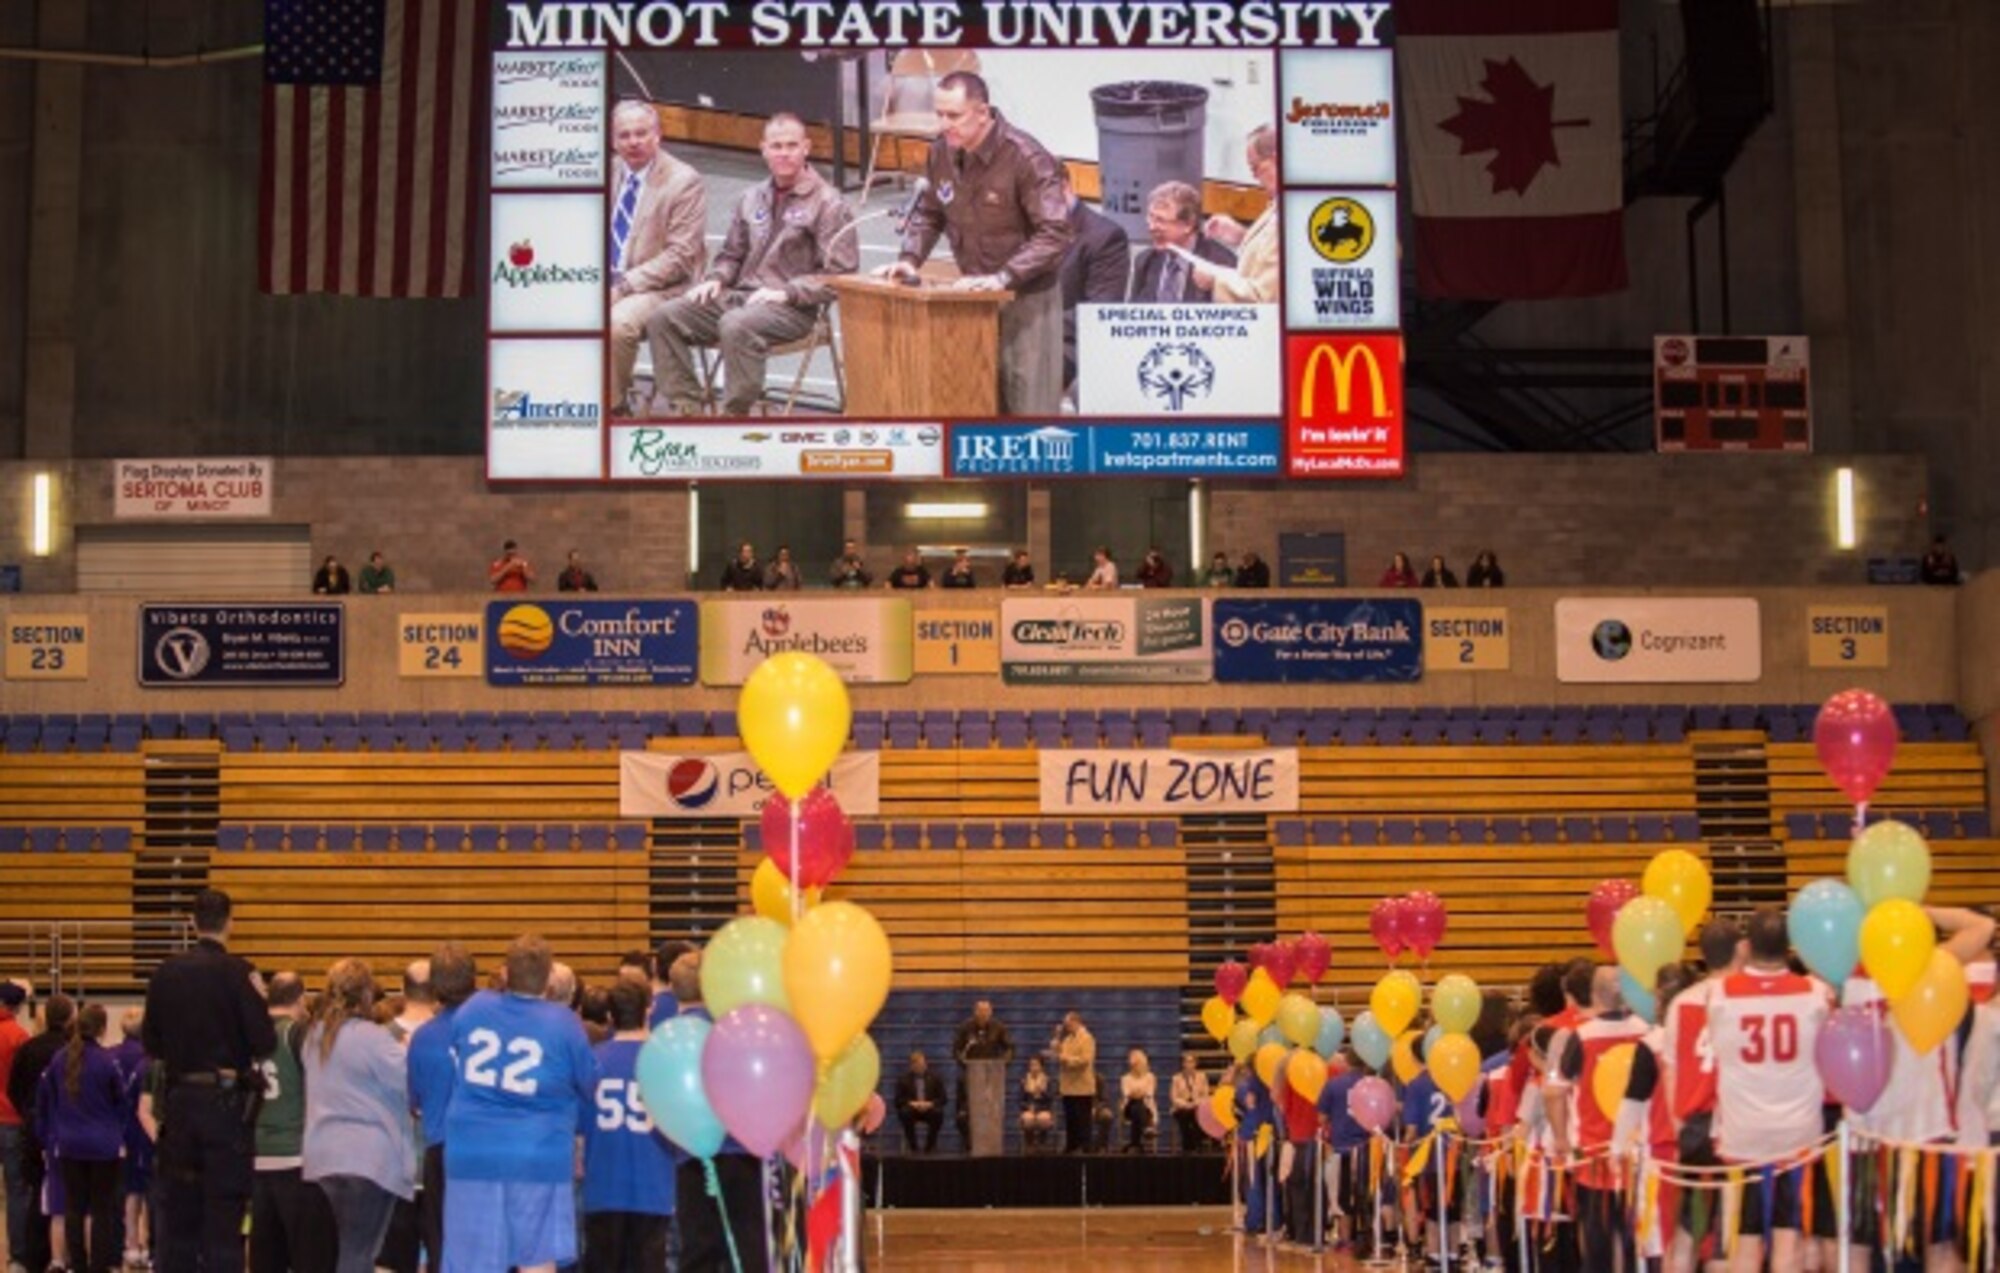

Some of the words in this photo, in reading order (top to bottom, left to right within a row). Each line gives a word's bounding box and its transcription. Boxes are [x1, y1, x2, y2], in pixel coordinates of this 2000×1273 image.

[506, 3, 728, 47] MINOT
[751, 3, 964, 46] STATE
[985, 2, 1390, 46] UNIVERSITY
[1312, 281, 1374, 298] WILD
[1098, 309, 1167, 321] SPECIAL
[1172, 309, 1258, 321] OLYMPICS
[1312, 299, 1374, 314] WINGS
[1110, 325, 1171, 337] NORTH
[1175, 325, 1249, 337] DAKOTA
[957, 435, 1048, 460] IRET
[1131, 432, 1249, 448] 701.837.RENT
[629, 428, 697, 475] Ryan
[956, 459, 1073, 472] PROPERTIES
[123, 481, 207, 498] SERTOMA
[214, 480, 263, 498] CLUB
[187, 500, 231, 512] MINOT
[216, 609, 337, 625] Orthodontics
[559, 609, 676, 636] Comfort
[1812, 617, 1884, 634] SECTION
[12, 626, 84, 644] SECTION
[403, 625, 478, 643] SECTION
[918, 620, 993, 639] SECTION
[1252, 622, 1301, 644] Gate
[1305, 620, 1347, 647] City
[1353, 619, 1410, 642] Bank
[1430, 620, 1504, 637] SECTION
[594, 639, 641, 657] INN
[1640, 630, 1727, 653] Cognizant
[1840, 639, 1856, 660] 3
[31, 648, 65, 669] 23
[425, 647, 461, 669] 24
[949, 644, 958, 665] 1
[1459, 640, 1475, 663] 2
[1066, 759, 1149, 805] FUN
[1164, 758, 1275, 802] ZONE
[1741, 1015, 1797, 1063] 30
[465, 1026, 543, 1096] 22
